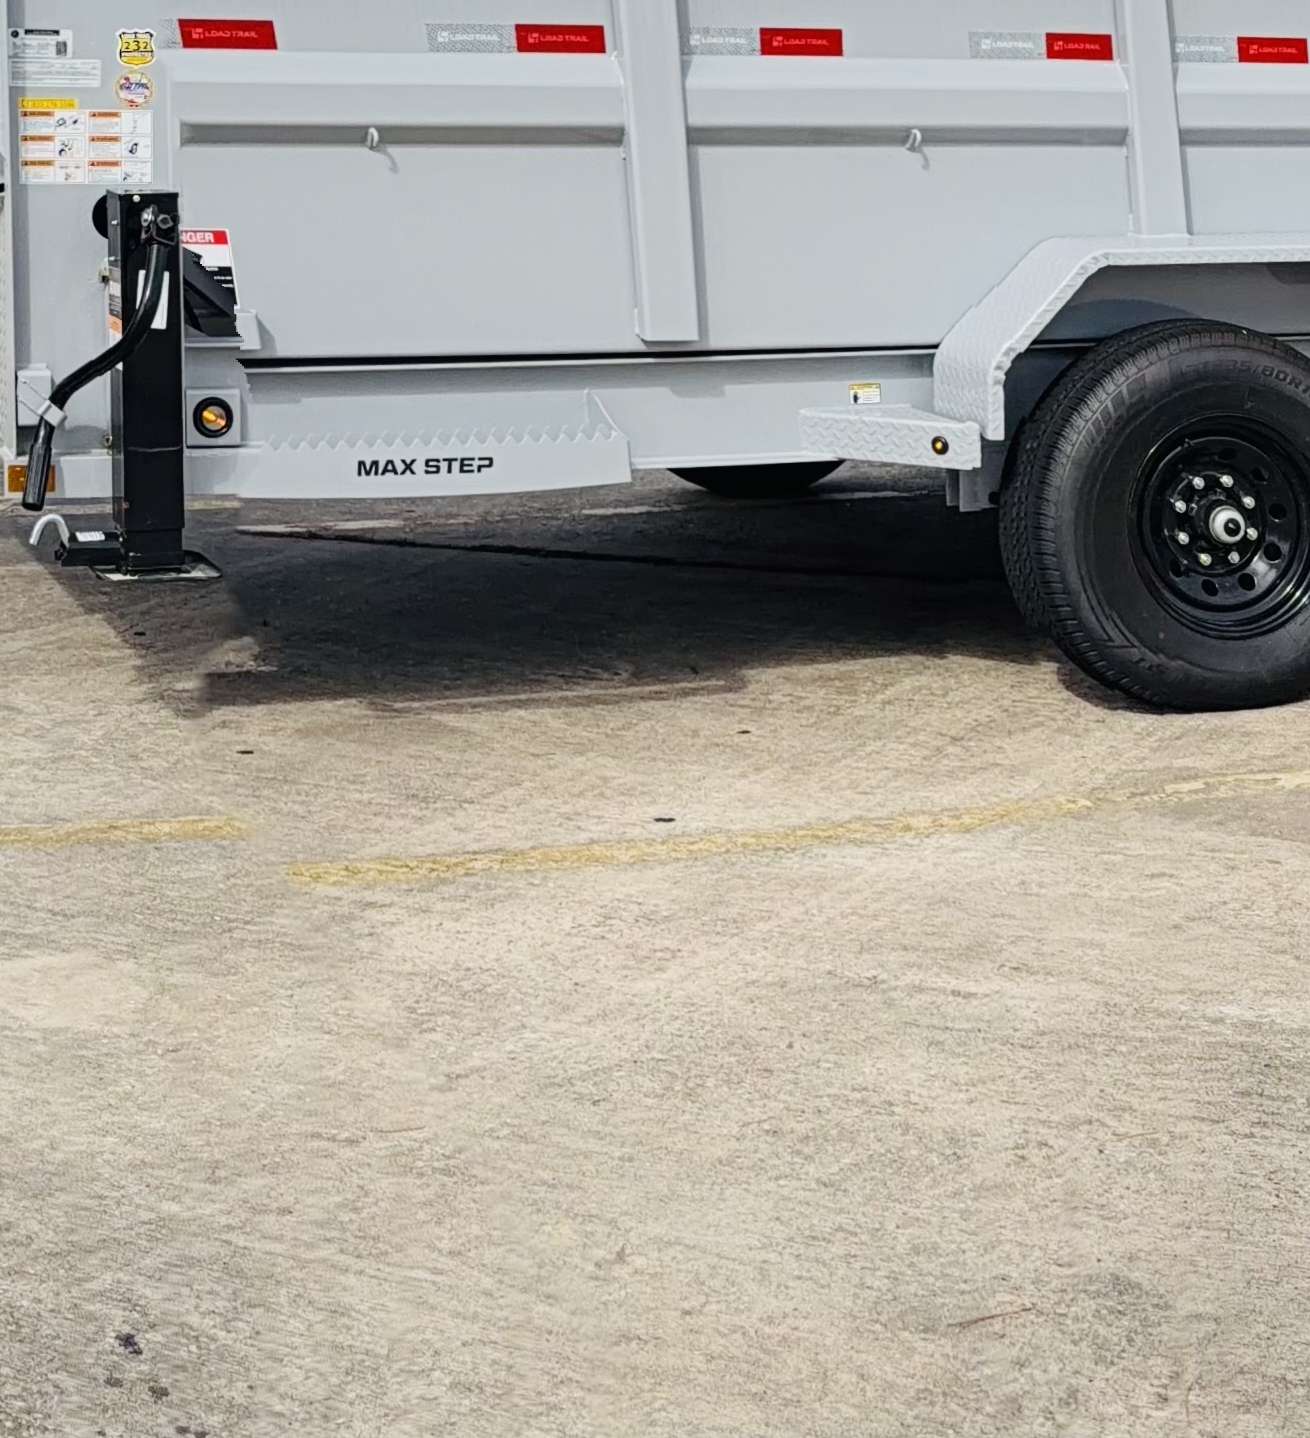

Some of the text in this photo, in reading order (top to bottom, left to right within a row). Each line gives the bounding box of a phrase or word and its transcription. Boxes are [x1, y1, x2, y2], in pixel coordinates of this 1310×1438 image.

[181, 231, 215, 244] NGER
[356, 456, 494, 477] MAX STEP
